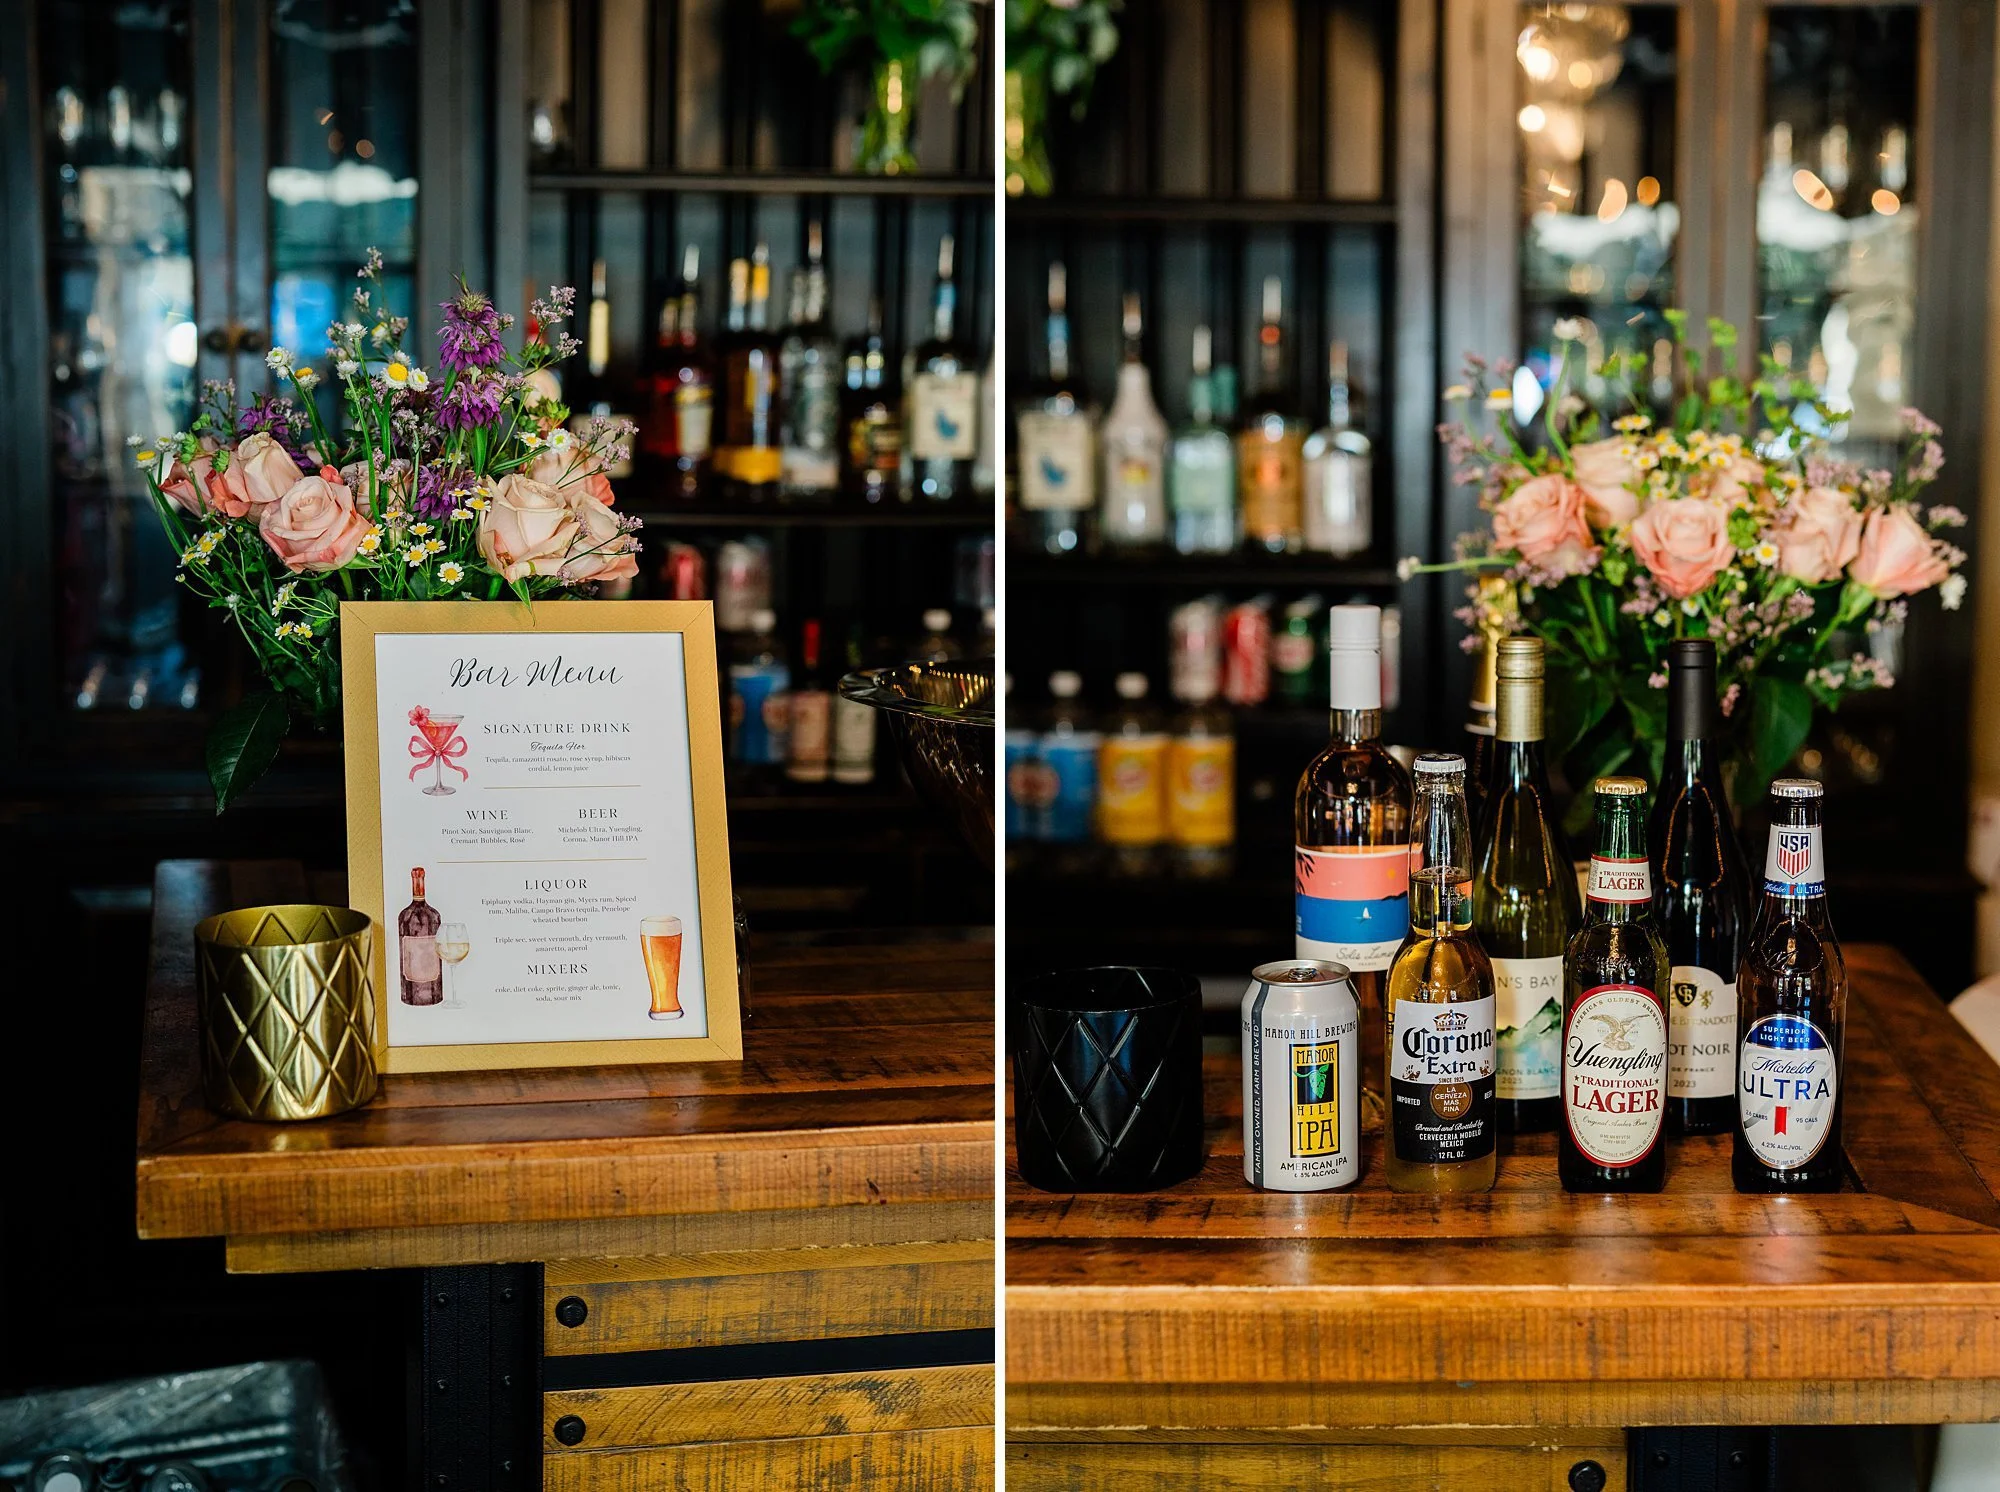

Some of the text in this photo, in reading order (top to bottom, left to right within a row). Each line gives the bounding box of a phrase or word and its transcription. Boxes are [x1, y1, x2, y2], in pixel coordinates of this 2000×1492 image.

[450, 655, 624, 687] Bar Menu
[484, 722, 631, 734] SIGNATURE DRINK
[530, 741, 563, 752] Tequila
[485, 756, 511, 765] Tequila,
[512, 755, 546, 763] ramazzotti
[584, 756, 604, 764] syrup,
[605, 754, 631, 762] hibiscus
[553, 764, 573, 772] lemon
[573, 764, 589, 773] juice
[466, 809, 508, 821] WINE
[578, 808, 618, 819] BEER
[479, 827, 513, 836] Sauvignon
[558, 825, 643, 834] Michelob Ultra, Yuengling,
[480, 837, 509, 845] Bubbles,
[589, 835, 611, 843] Manor
[1780, 834, 1809, 852] USA
[525, 878, 588, 893] LIQUOR
[1598, 876, 1645, 890] LAGER
[1797, 885, 1823, 894] ULTRA
[481, 898, 511, 907] Epiphany
[513, 897, 535, 905] vodka,
[536, 897, 563, 906] Hayman
[564, 897, 577, 906] gin,
[578, 896, 599, 905] Myers
[615, 895, 637, 904] Spiced
[505, 907, 530, 915] Malibu,
[531, 906, 554, 915] Campo
[556, 906, 575, 914] Bravo
[576, 905, 601, 914] tequila,
[601, 905, 631, 914] Penelope
[532, 915, 588, 923] wheated bourbon
[495, 937, 514, 945] Triple
[548, 935, 581, 943] vermouth,
[582, 934, 594, 943] dry
[535, 944, 588, 953] amaretto, aperol
[527, 963, 588, 975] MIXERS
[1530, 974, 1559, 989] BAY
[513, 985, 527, 993] diet
[546, 985, 567, 994] sprite,
[567, 984, 588, 993] ginger
[602, 983, 621, 991] tonic,
[535, 994, 553, 1002] soda,
[1575, 1000, 1604, 1030] AMERICA'S
[1607, 997, 1640, 1005] OLDEST
[1265, 1020, 1357, 1039] MANOR HILL BREWING
[1763, 1025, 1807, 1035] SUPERIOR
[1760, 1033, 1785, 1043] LIGHT
[1402, 1027, 1492, 1063] Corona
[1692, 1043, 1731, 1056] NOIR
[1296, 1048, 1335, 1064] MANOR
[1567, 1036, 1663, 1076] Yuengling
[1427, 1056, 1476, 1075] Extra
[1752, 1056, 1816, 1075] Michelob
[1580, 1074, 1655, 1089] TRADITIONAL
[1743, 1071, 1830, 1100] ULTRA
[1434, 1092, 1467, 1100] CERVEZA
[1572, 1085, 1659, 1113] LAGER
[1297, 1103, 1335, 1116] HILL
[1443, 1105, 1460, 1113] FINA
[1582, 1115, 1648, 1127] Original Amber Beer
[1753, 1112, 1768, 1121] CARBS
[1415, 1119, 1484, 1132] Brewed and Bottled by
[1297, 1119, 1335, 1151] IPA
[1419, 1128, 1482, 1141] CERVECERIA MODELO
[1440, 1139, 1464, 1148] MEXICO
[1761, 1141, 1776, 1149] 4.2%
[1456, 1150, 1466, 1158] OZ.
[1280, 1156, 1348, 1171] AMERICAN IPA
